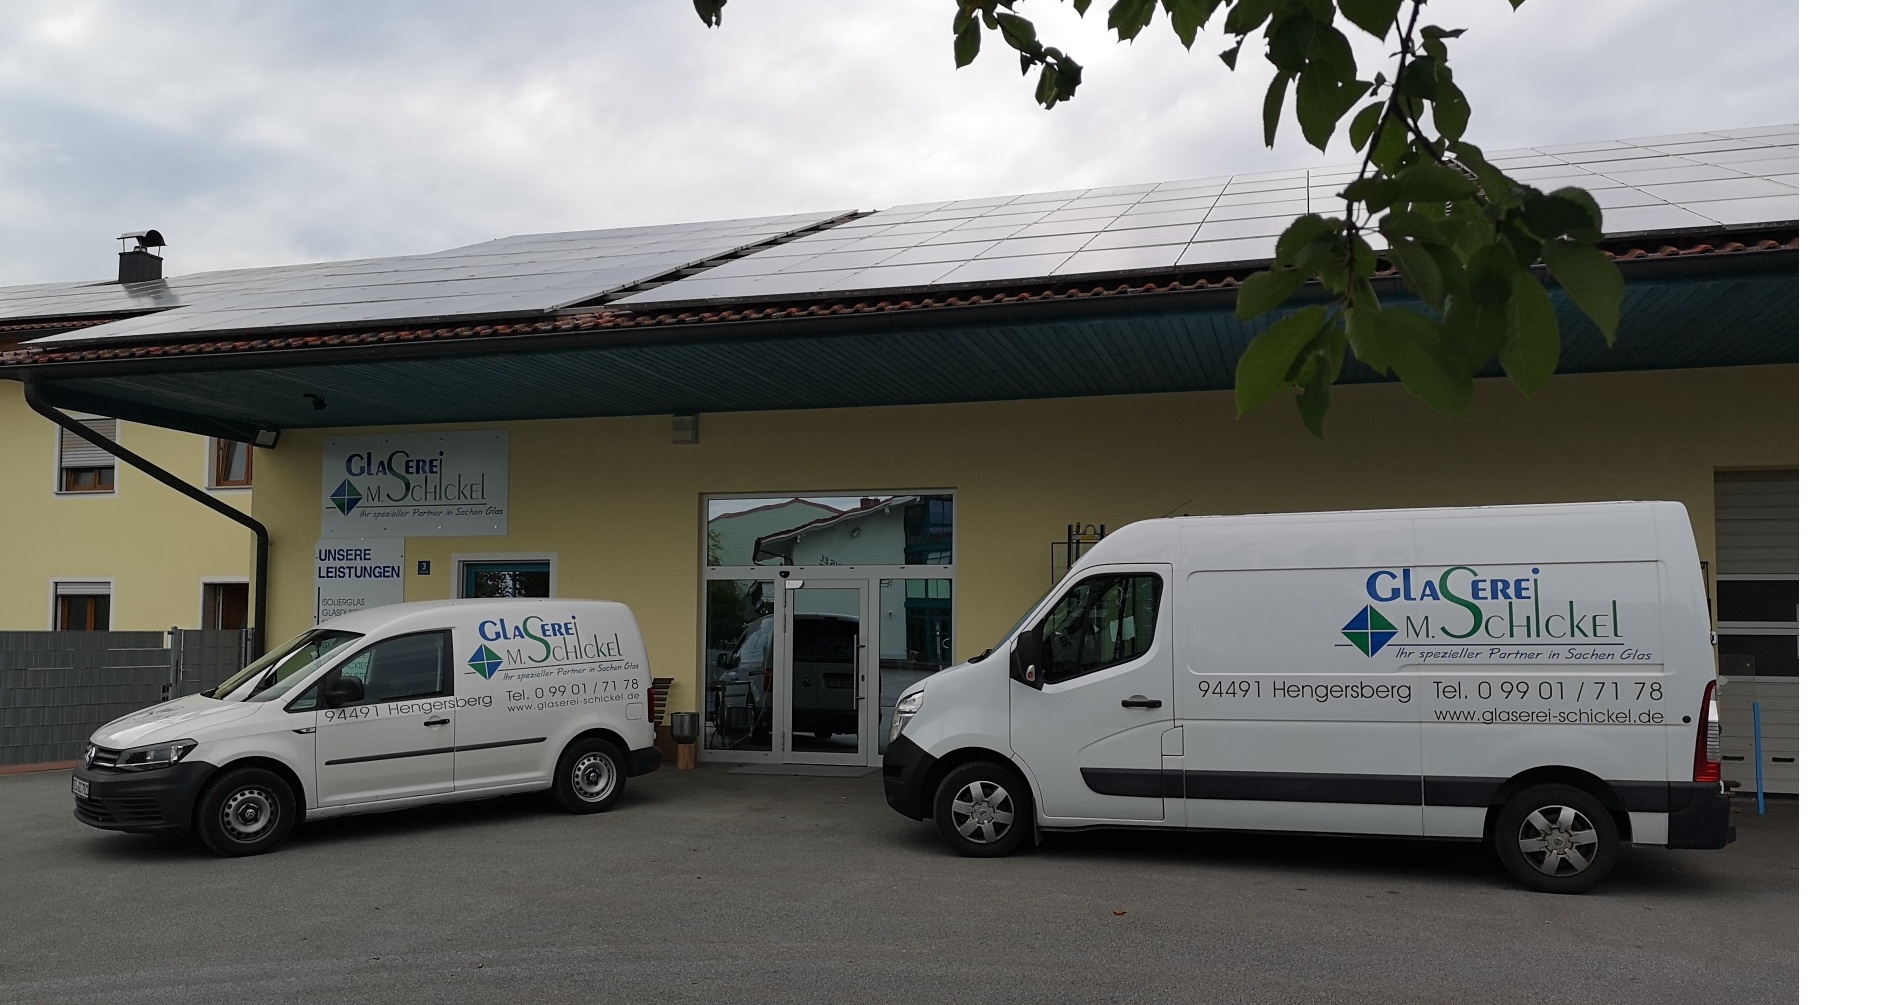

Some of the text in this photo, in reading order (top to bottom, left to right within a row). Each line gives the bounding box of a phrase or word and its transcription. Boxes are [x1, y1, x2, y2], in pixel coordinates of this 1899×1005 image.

[366, 486, 384, 502] M.
[359, 506, 503, 519] Ihr spezieller Partner in Sachen Glas
[318, 548, 372, 561] UNSERE
[318, 565, 401, 579] LEISTUNGEN
[421, 562, 427, 570] 3
[321, 598, 365, 607] ISOLIERGLAS
[1405, 615, 1435, 639] M.
[506, 648, 526, 666] M.
[1396, 646, 1652, 662] Ihr spezieller Partner in Sachen Glas
[503, 661, 639, 682] Ihr spezieller Partner in Sachen Glas
[506, 679, 639, 702] Tel. 0 99 01 / 71 78
[1198, 681, 1412, 703] 94491 Hengersberg
[1432, 681, 1664, 702] Tel. 0 99 01 / 71 78
[324, 695, 493, 723] 94491 Hengersberg
[1434, 707, 1664, 724] www.glaserei-schickel.de
